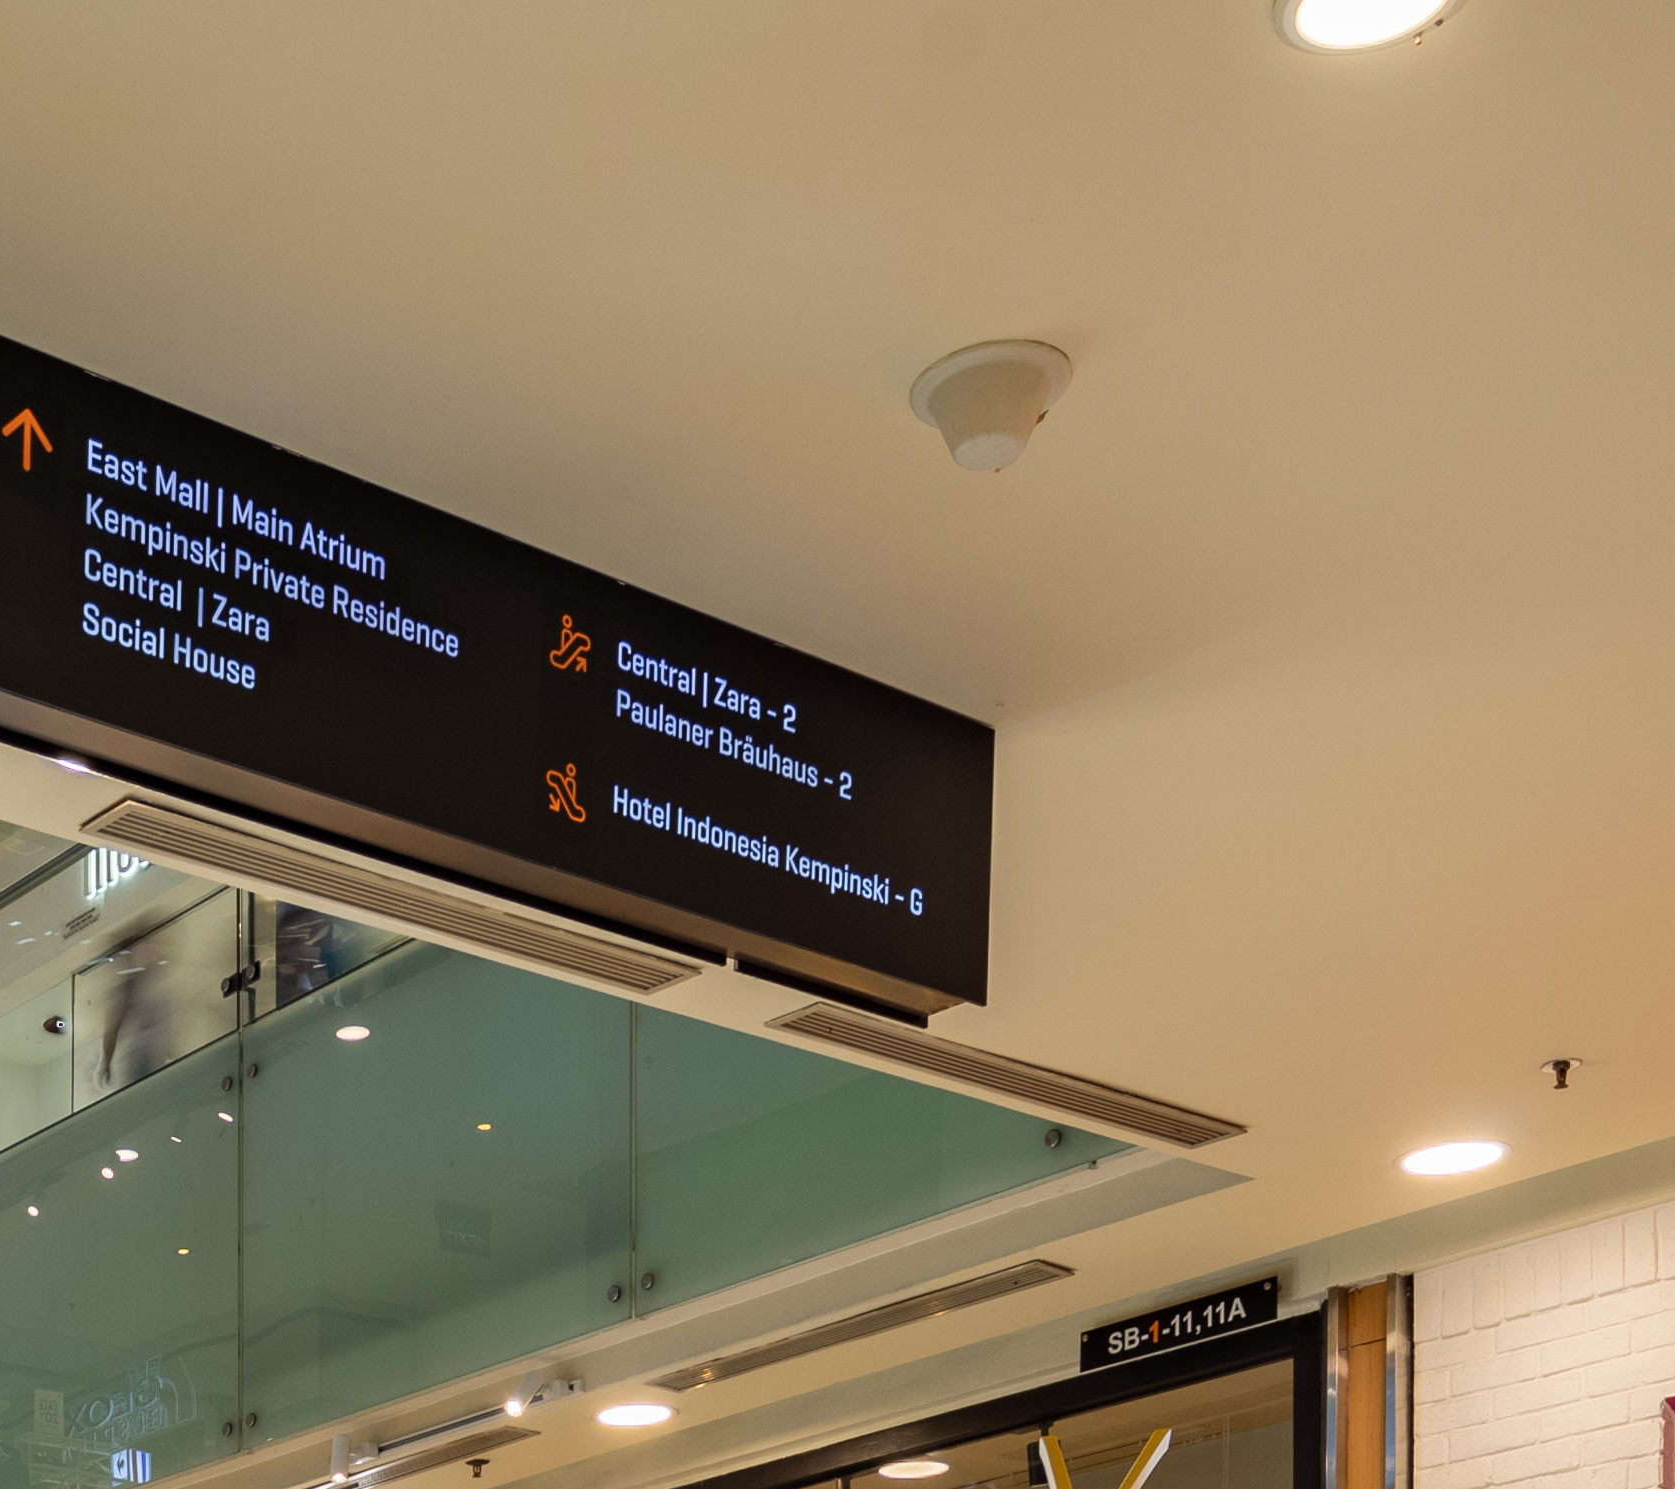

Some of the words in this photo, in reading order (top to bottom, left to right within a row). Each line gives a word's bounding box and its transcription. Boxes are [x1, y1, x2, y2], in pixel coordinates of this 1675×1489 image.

[86, 438, 147, 492] East
[154, 464, 209, 514] Mall
[231, 494, 293, 546] Main
[300, 522, 386, 581] Atrium
[84, 548, 183, 612] Central
[211, 593, 271, 643] Zara
[85, 493, 227, 574] Kempinski
[234, 548, 326, 610] Private
[332, 584, 460, 659] Residence
[82, 602, 165, 660] Social
[173, 633, 257, 690] House
[617, 641, 697, 697] Central
[714, 676, 762, 721] Zara
[782, 703, 797, 734] 2
[616, 688, 714, 749] Paulaner
[718, 726, 819, 788] Bräuhaus
[838, 770, 853, 801] 2
[613, 784, 671, 831] Hotel
[676, 806, 780, 869] Indonesia
[784, 843, 890, 906] Kempinski
[909, 888, 924, 917] G
[1107, 1296, 1247, 1355] SB-1-11,11A
